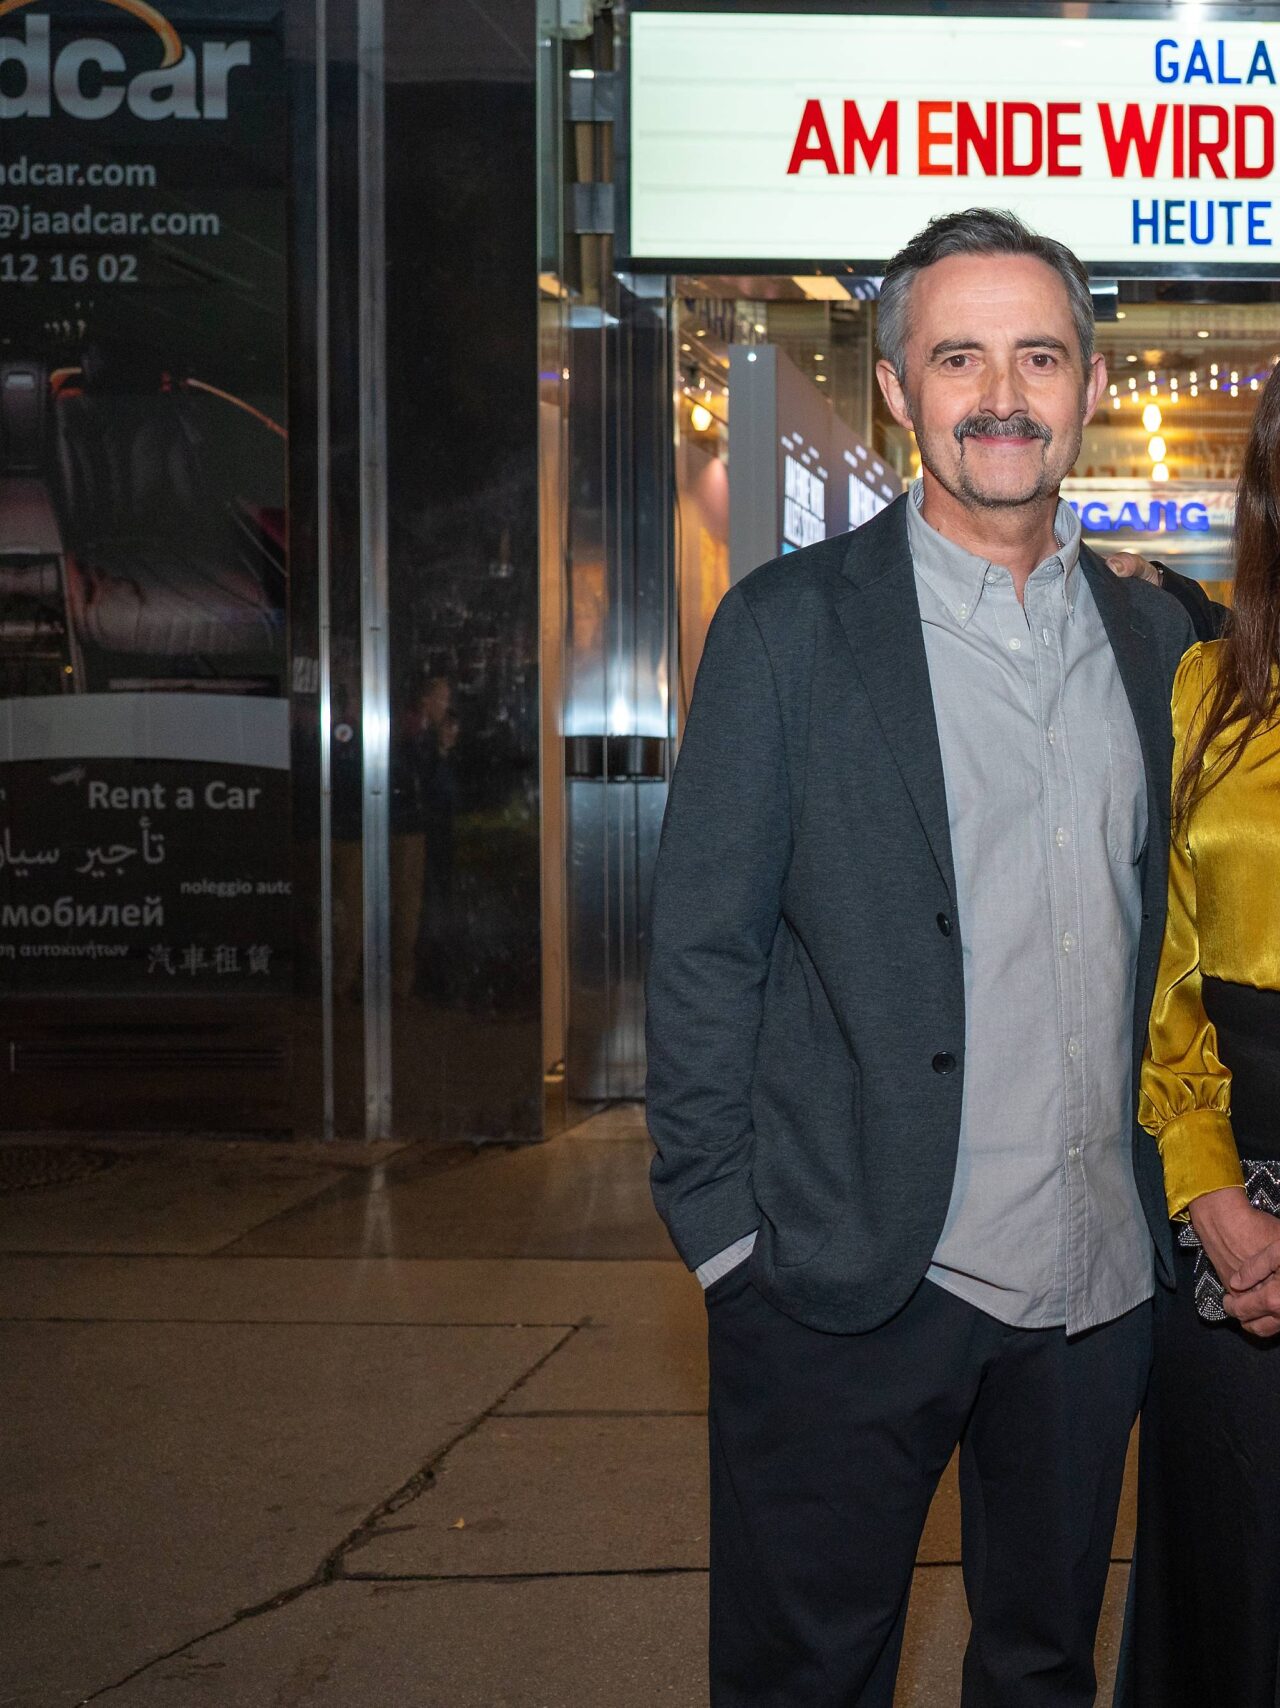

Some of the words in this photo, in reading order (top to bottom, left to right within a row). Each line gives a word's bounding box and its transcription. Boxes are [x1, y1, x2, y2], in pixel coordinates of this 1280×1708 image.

[787, 99, 898, 175] AM
[918, 101, 1081, 176] ENDE
[1098, 103, 1275, 179] WIRD
[1132, 200, 1272, 245] HEUTE
[50, 254, 88, 282] 16
[98, 254, 138, 282] 02
[88, 781, 166, 809] Rent
[175, 788, 195, 809] a
[204, 781, 261, 809] Car
[76, 816, 166, 878] تأجير
[180, 879, 253, 898] noleggio
[3, 896, 164, 928] мобилей
